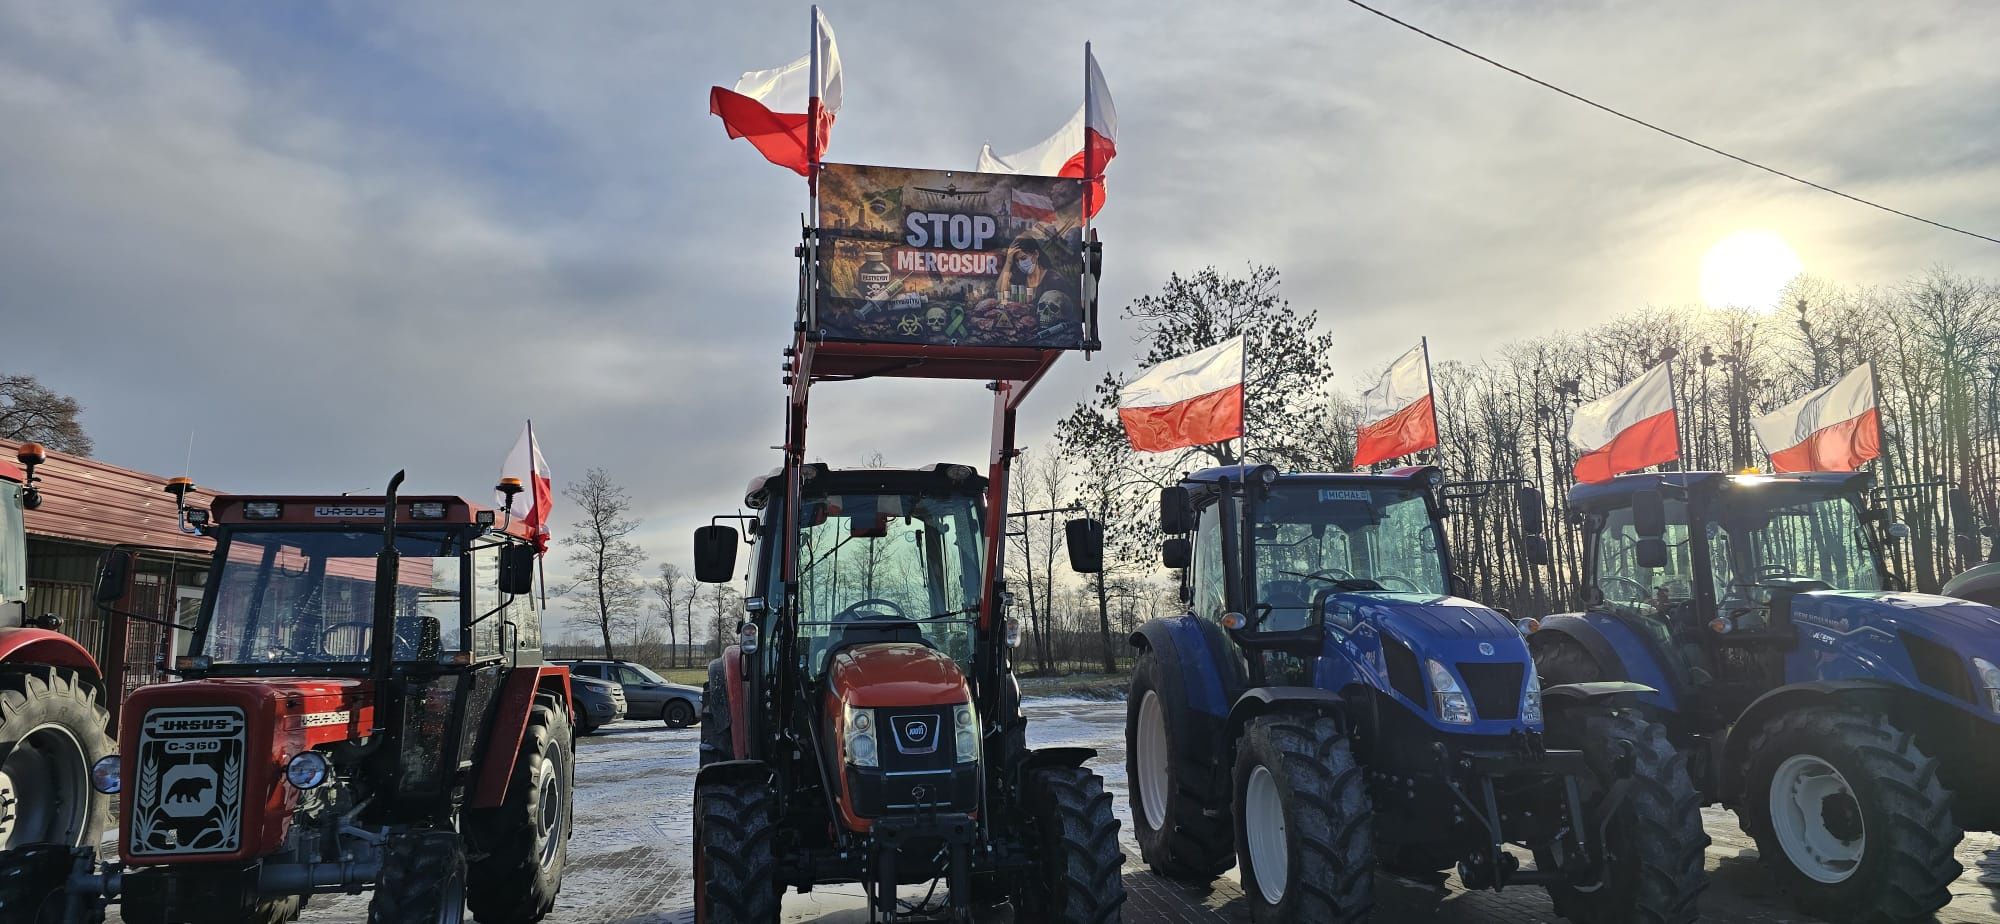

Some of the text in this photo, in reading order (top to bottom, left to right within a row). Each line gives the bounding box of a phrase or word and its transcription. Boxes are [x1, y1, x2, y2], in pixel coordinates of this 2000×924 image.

[906, 211, 996, 250] STOP
[897, 250, 999, 275] MERCOSUR
[317, 508, 384, 516] URSUS
[159, 719, 232, 731] URSUS
[168, 741, 219, 751] C-360
